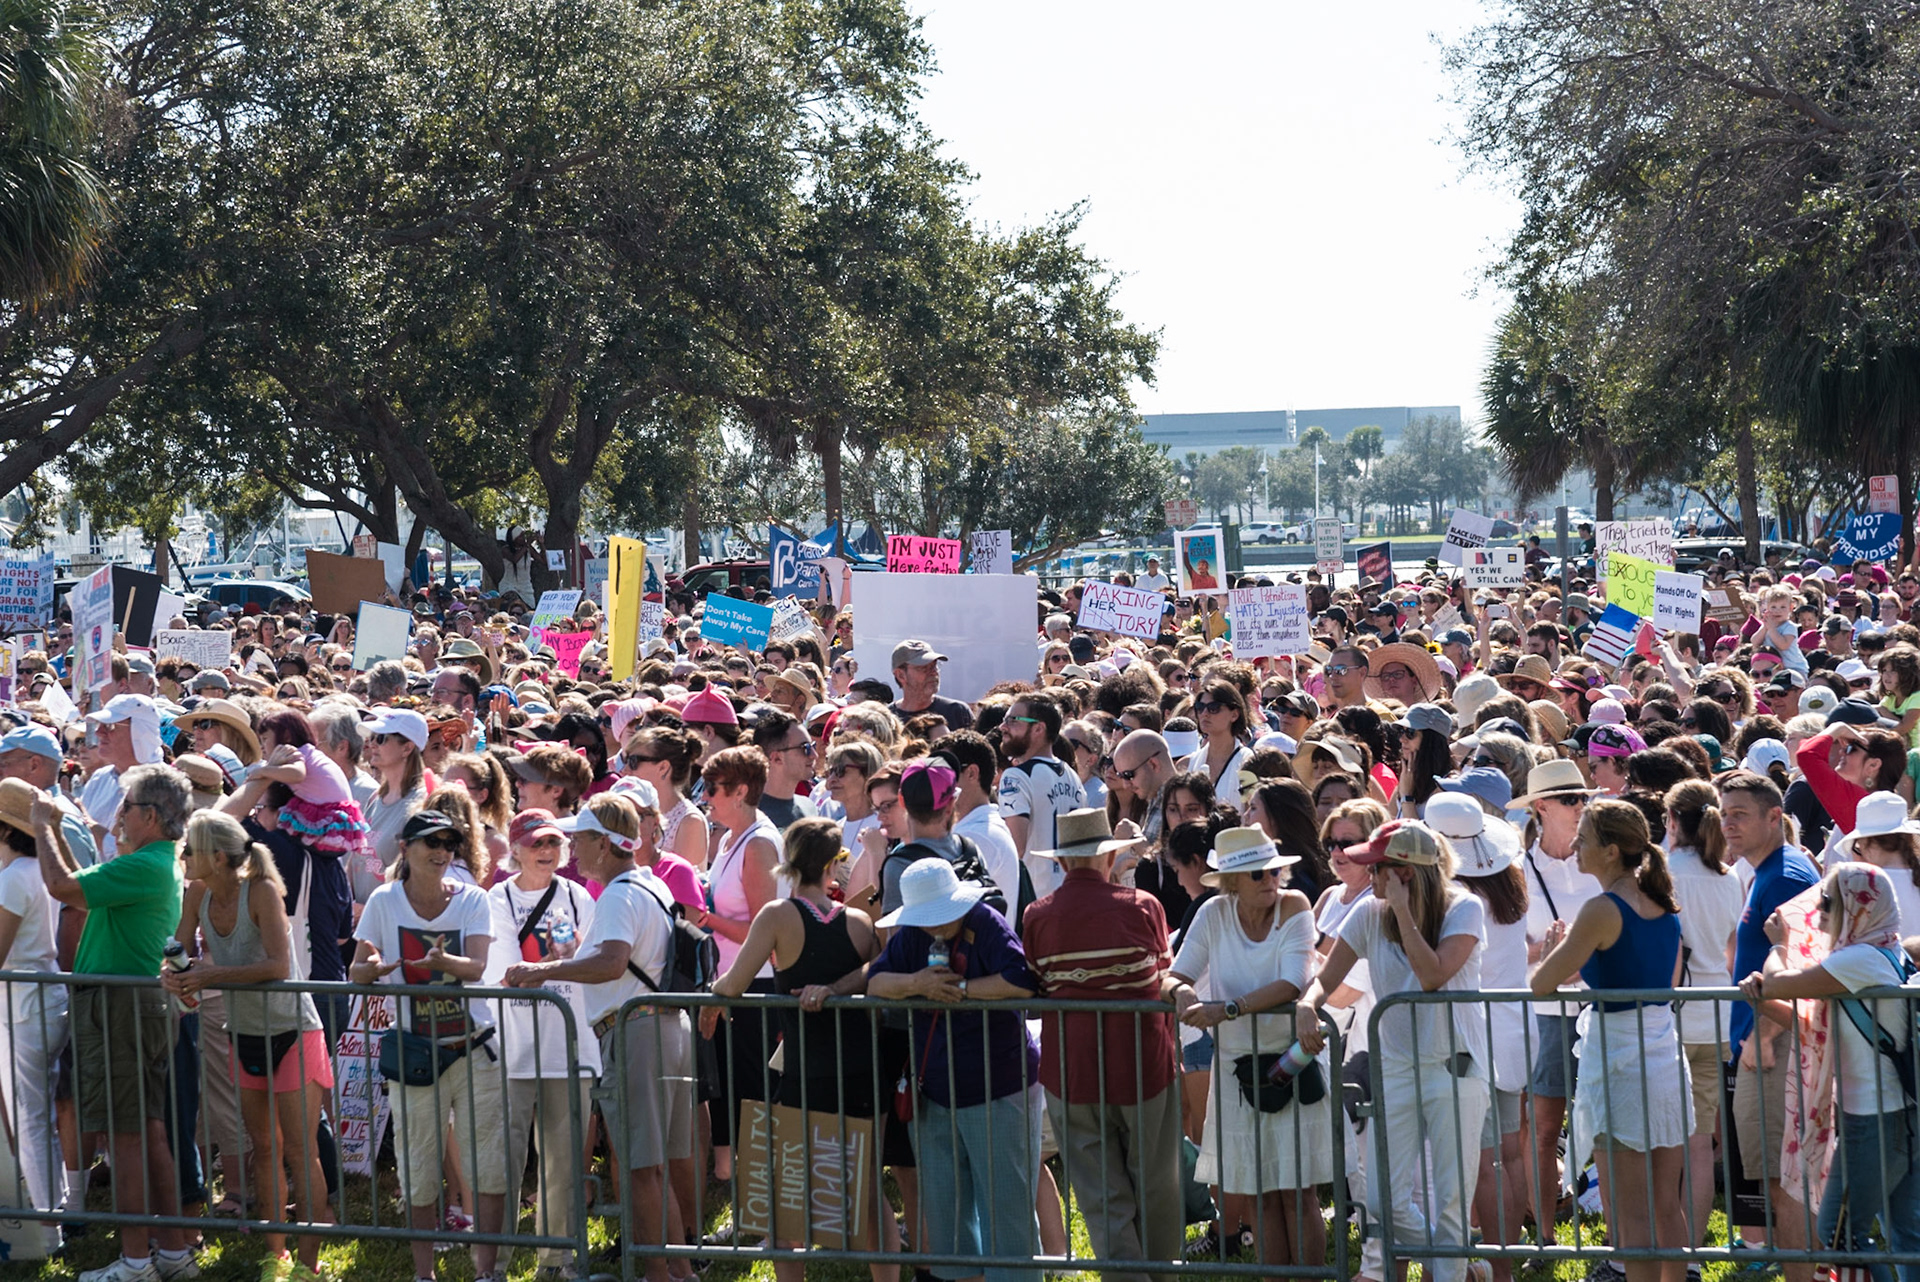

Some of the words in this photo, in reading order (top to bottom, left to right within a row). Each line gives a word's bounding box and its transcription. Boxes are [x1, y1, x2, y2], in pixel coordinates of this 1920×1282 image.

[1872, 478, 1884, 490] NO
[1853, 514, 1884, 528] NOT
[972, 532, 1002, 546] NATIVE
[1450, 526, 1468, 538] BLACK
[1469, 532, 1485, 543] LIVES
[1600, 522, 1627, 548] They
[1629, 522, 1657, 538] tried
[1660, 524, 1670, 536] to
[1856, 528, 1878, 540] MY
[891, 537, 912, 556] I'M
[919, 542, 957, 559] JUST
[1646, 540, 1671, 560] They
[889, 558, 920, 573] Here
[17, 588, 38, 596] FOR
[1084, 583, 1158, 610] MAKING
[1230, 589, 1256, 604] TRUE
[1260, 587, 1299, 602] Patriotism
[1686, 590, 1697, 599] Our
[1089, 599, 1116, 612] HER
[1235, 603, 1263, 618] HATES
[1267, 601, 1306, 620] Injustice
[1659, 604, 1672, 614] Civil
[1675, 606, 1695, 619] Rights
[16, 614, 29, 622] WE
[706, 605, 730, 617] Don't
[733, 611, 752, 622] Take
[704, 616, 728, 629] Away
[730, 621, 744, 633] My
[745, 626, 768, 637] Care.
[1237, 618, 1246, 630] in
[1264, 619, 1279, 629] own
[1282, 615, 1301, 627] land
[648, 627, 662, 636] WE!
[1237, 630, 1252, 640] more
[1256, 629, 1270, 640] than
[546, 635, 560, 651] MY
[780, 1142, 805, 1210] HURTS
